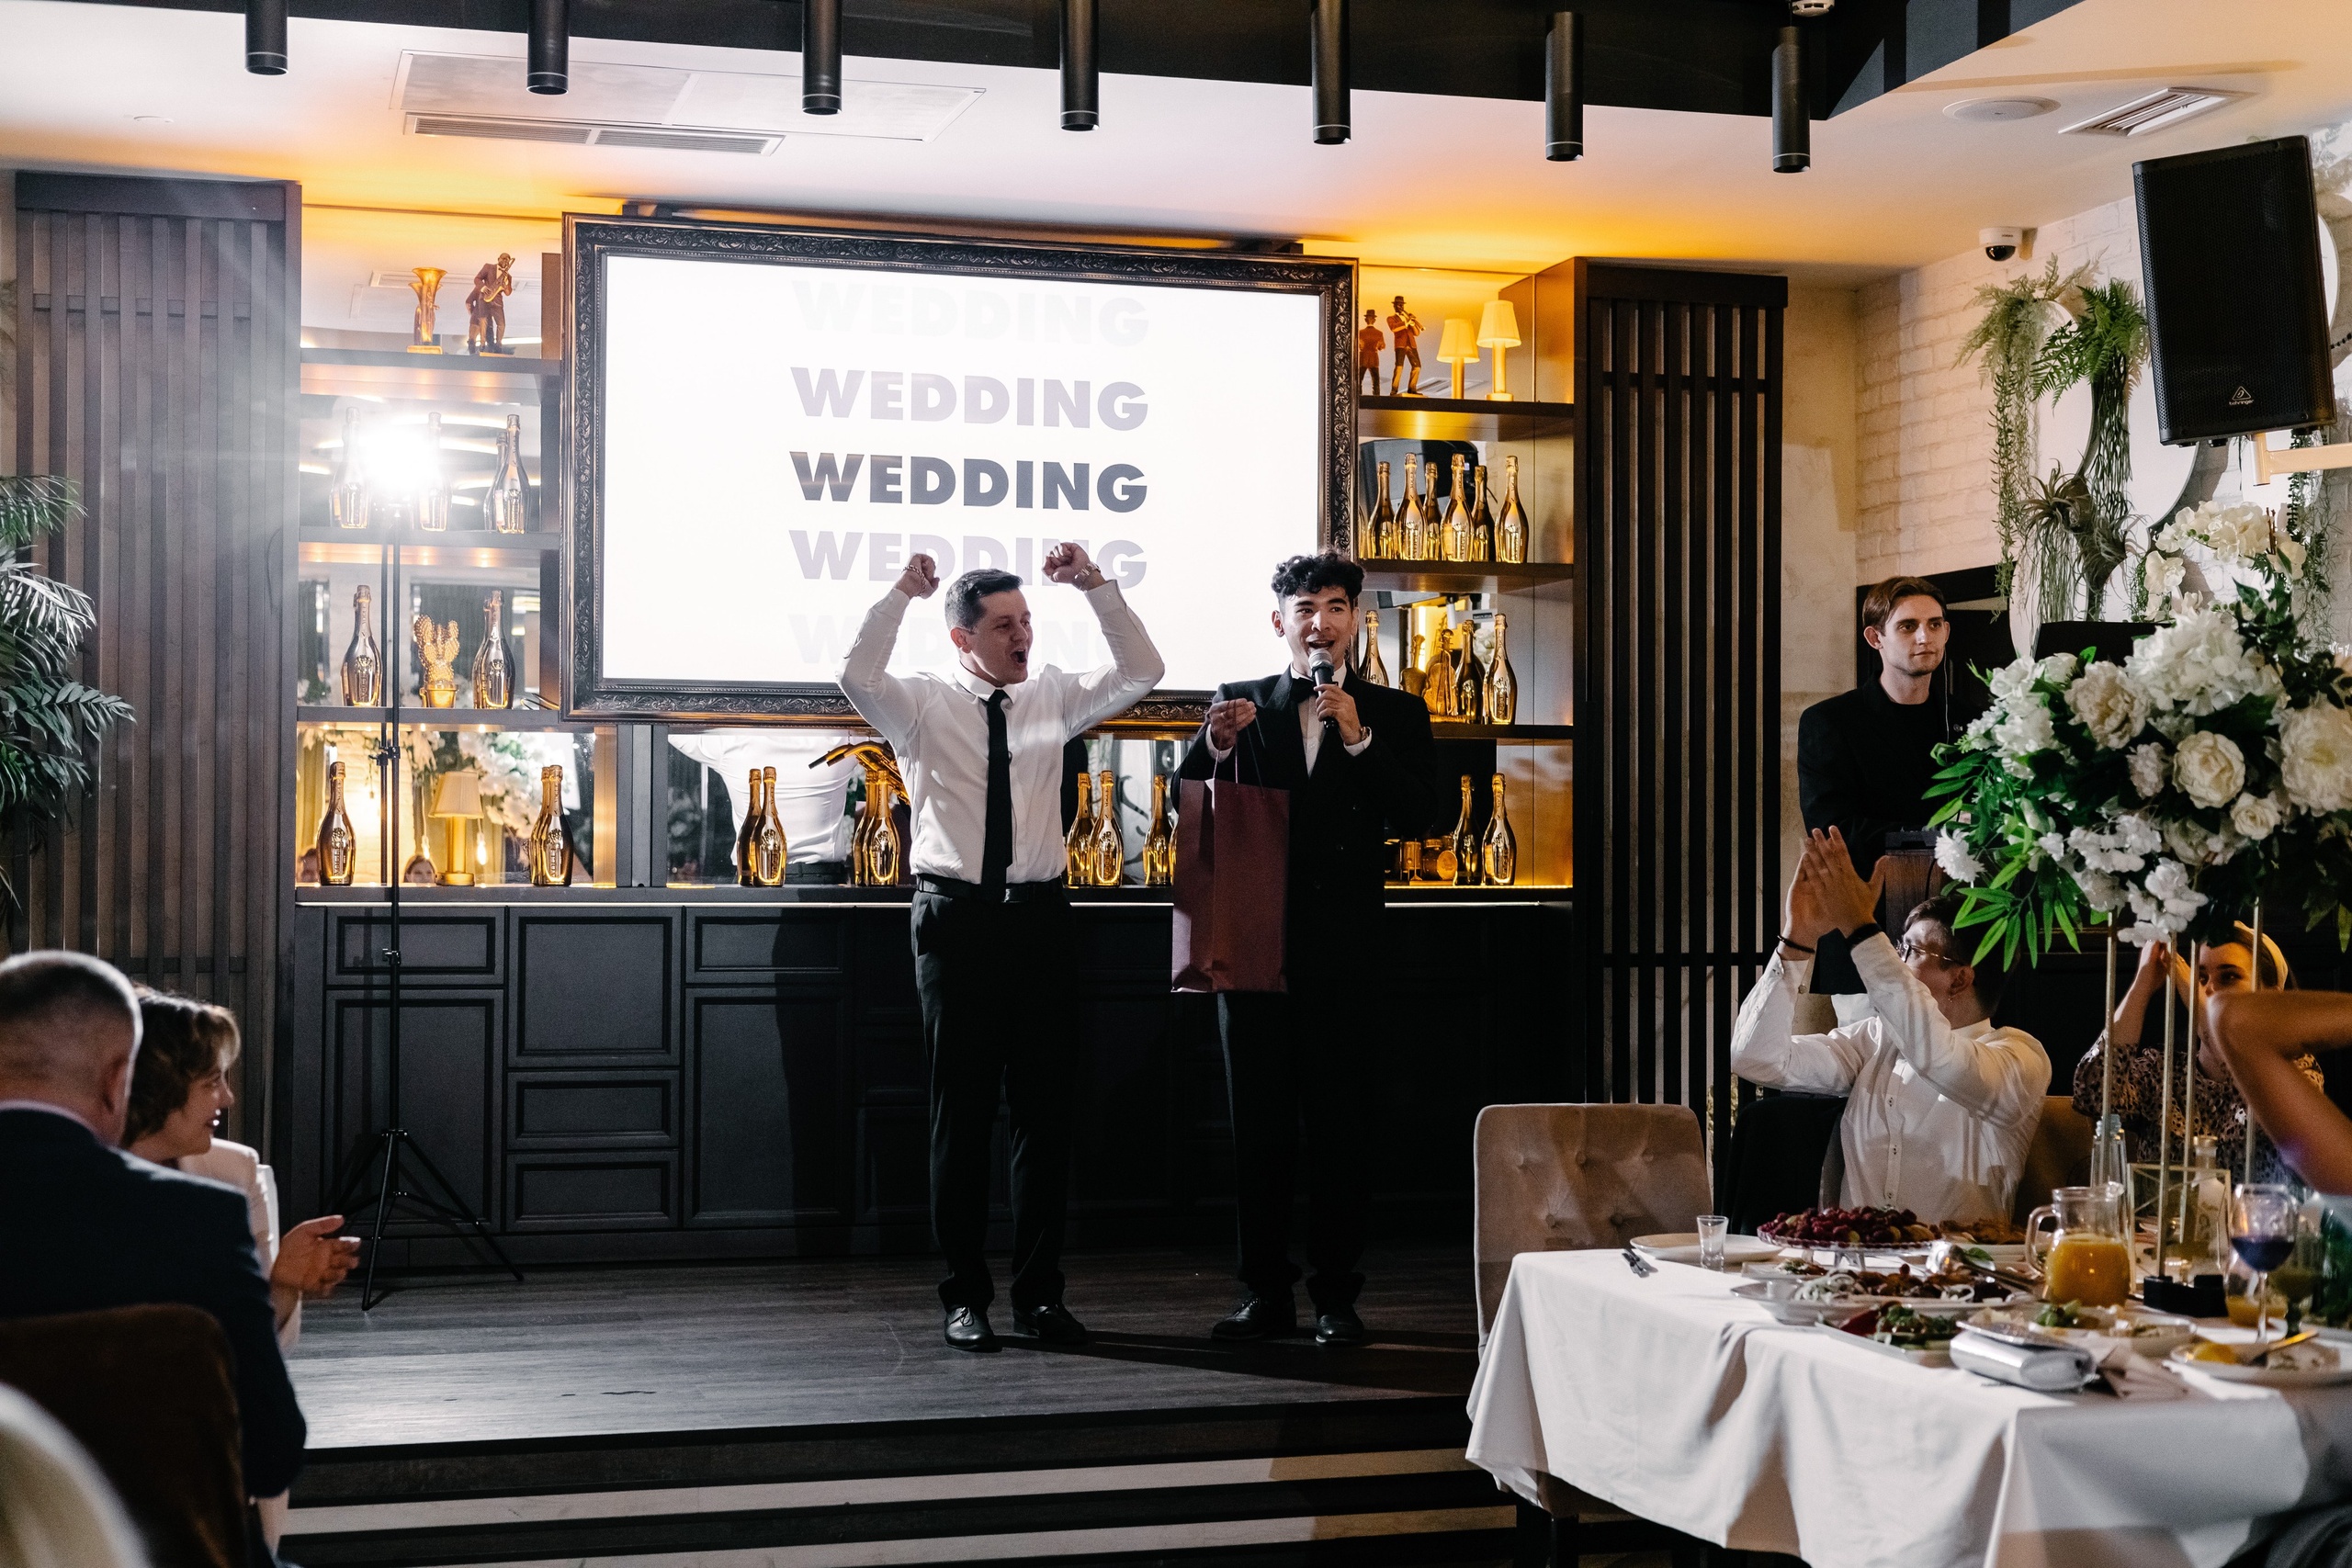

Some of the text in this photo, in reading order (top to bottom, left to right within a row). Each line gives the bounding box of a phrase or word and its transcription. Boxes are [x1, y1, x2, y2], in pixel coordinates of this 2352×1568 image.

[791, 280, 1149, 347] WEDDING
[790, 367, 1148, 431] WEDDING
[789, 451, 1148, 513] WEDDING
[788, 530, 1147, 590] WEDDIG
